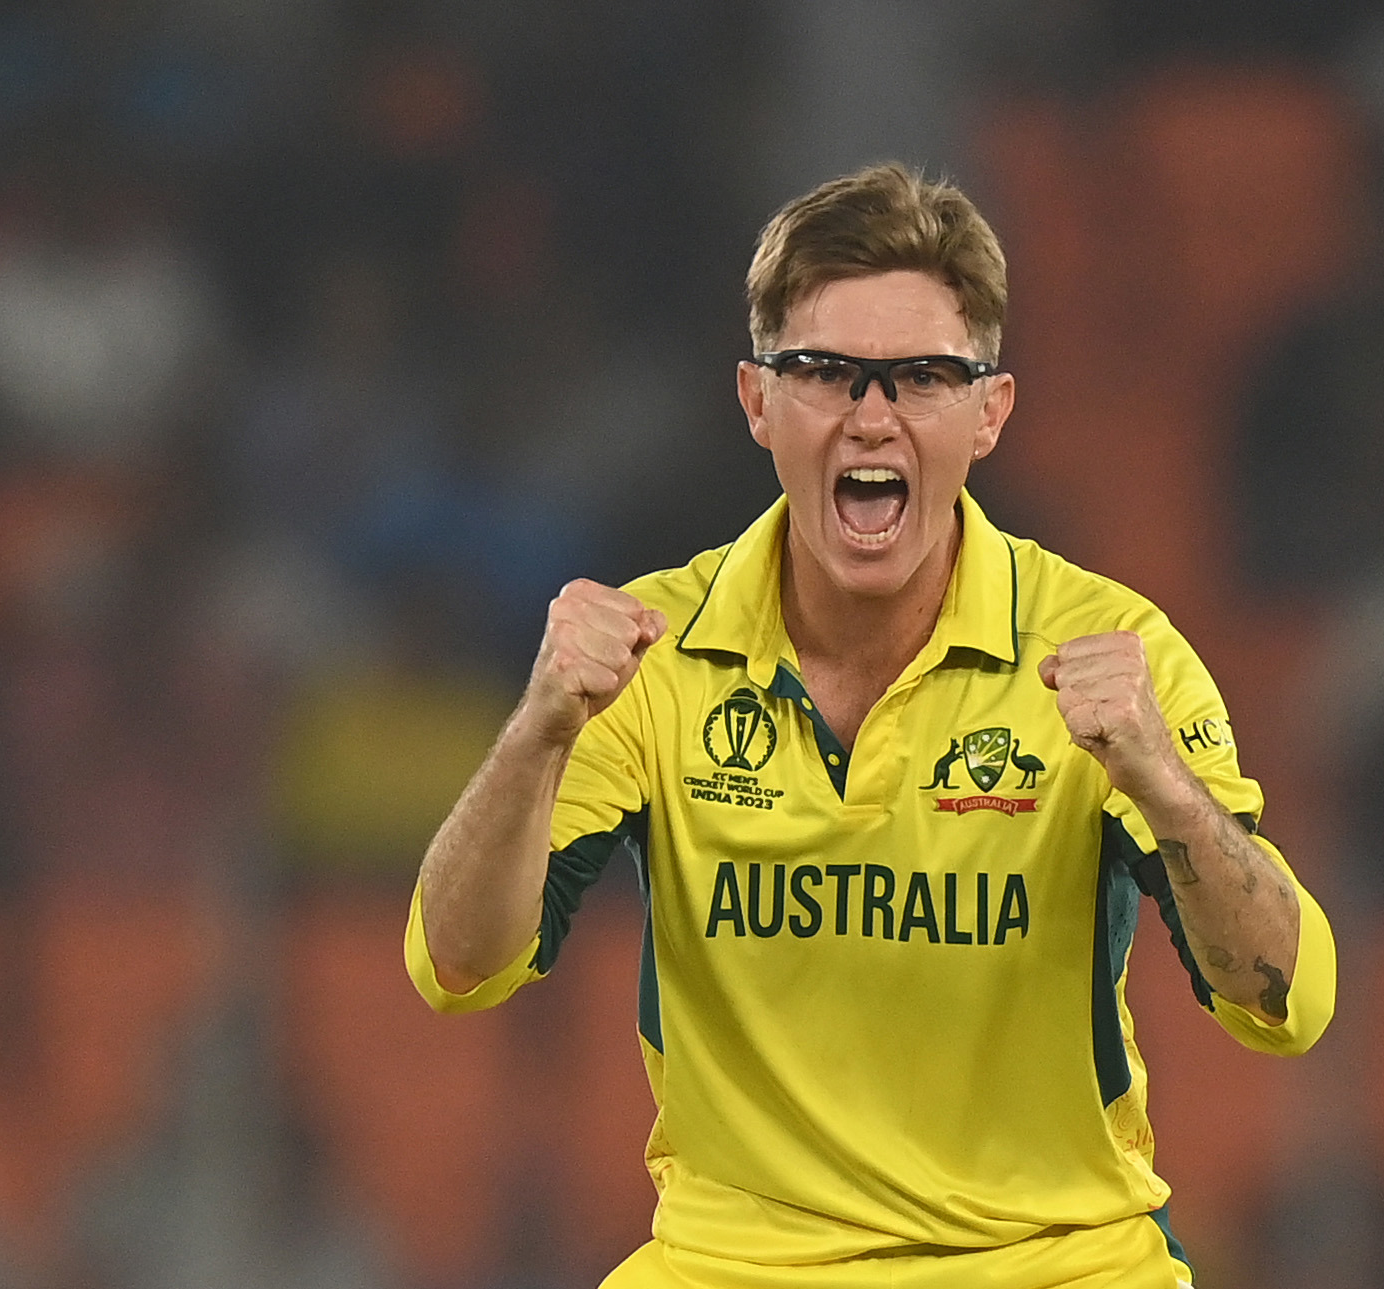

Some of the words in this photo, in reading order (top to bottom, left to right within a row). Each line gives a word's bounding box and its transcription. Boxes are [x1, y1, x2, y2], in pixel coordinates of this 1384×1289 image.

[683, 777, 725, 790] CRICKET
[727, 783, 763, 796] WORLD
[763, 789, 785, 798] CUP
[691, 788, 732, 804] INDIA
[735, 795, 774, 810] 2023
[959, 798, 1013, 813] AUSTRALIA
[705, 862, 1030, 945] AUSTRALIA
